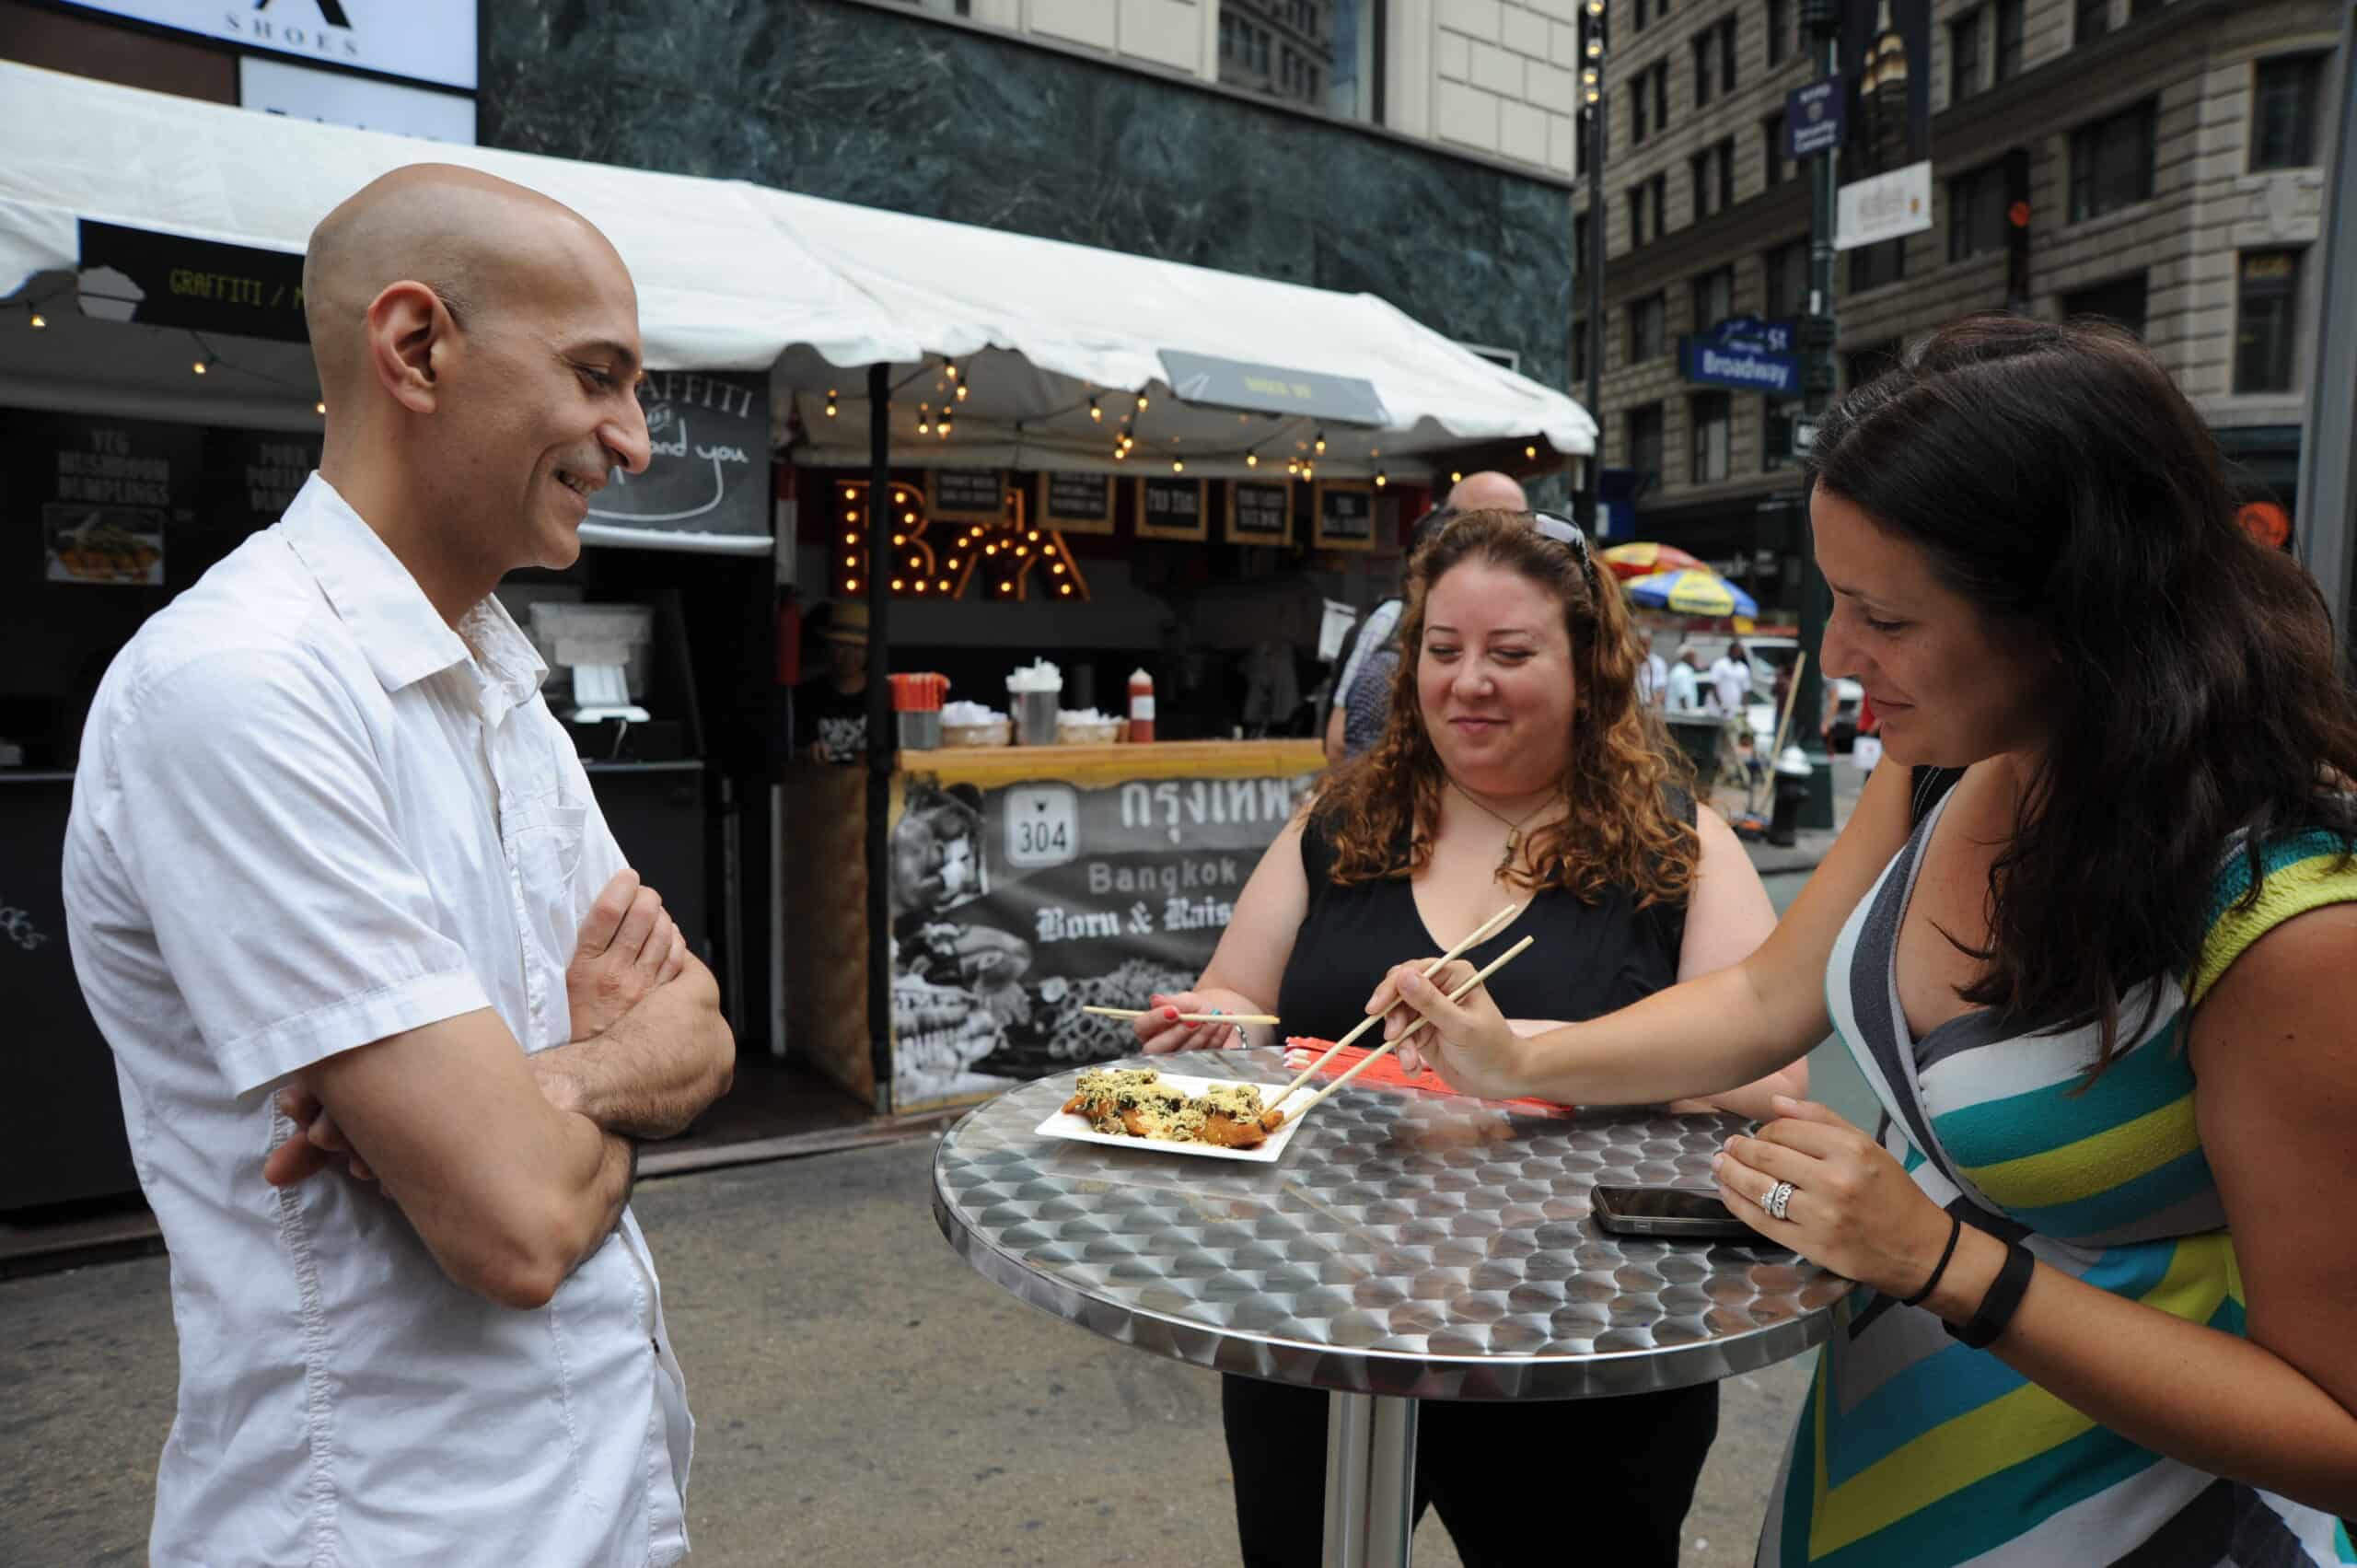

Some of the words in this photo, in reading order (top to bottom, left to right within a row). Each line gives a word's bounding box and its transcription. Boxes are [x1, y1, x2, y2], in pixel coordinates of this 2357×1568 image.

[226, 14, 358, 56] SHOES
[168, 267, 264, 308] GRAFFITI
[1701, 349, 1791, 389] Broadway
[637, 369, 753, 419] AFFITI
[1019, 821, 1067, 854] 304
[1088, 856, 1237, 897] Bangkok
[1036, 906, 1120, 943] Born
[1128, 901, 1155, 935] &
[1163, 896, 1235, 932] Rais
